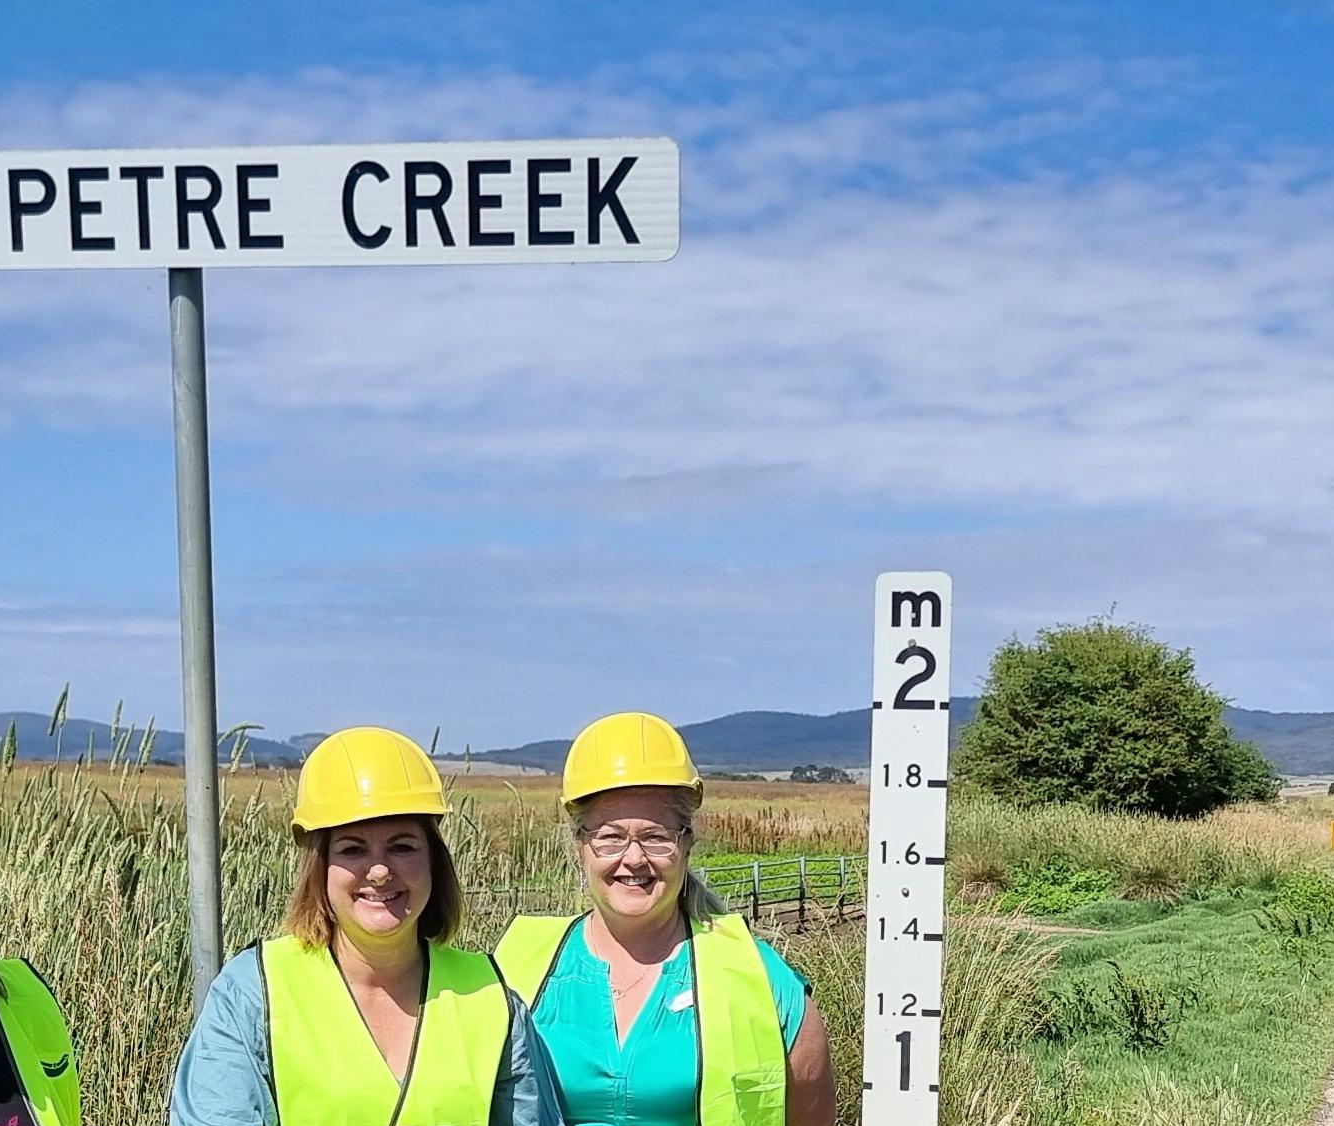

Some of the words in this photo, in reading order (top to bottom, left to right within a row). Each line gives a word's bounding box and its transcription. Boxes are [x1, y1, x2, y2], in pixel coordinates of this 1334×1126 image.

[341, 156, 641, 250] CREEK
[891, 590, 942, 628] m
[892, 642, 937, 710] 2
[883, 763, 922, 788] 1.8
[880, 840, 921, 866] 1.6
[879, 917, 920, 941] 1.4
[877, 992, 918, 1017] 1.2
[895, 1030, 911, 1091] 1
